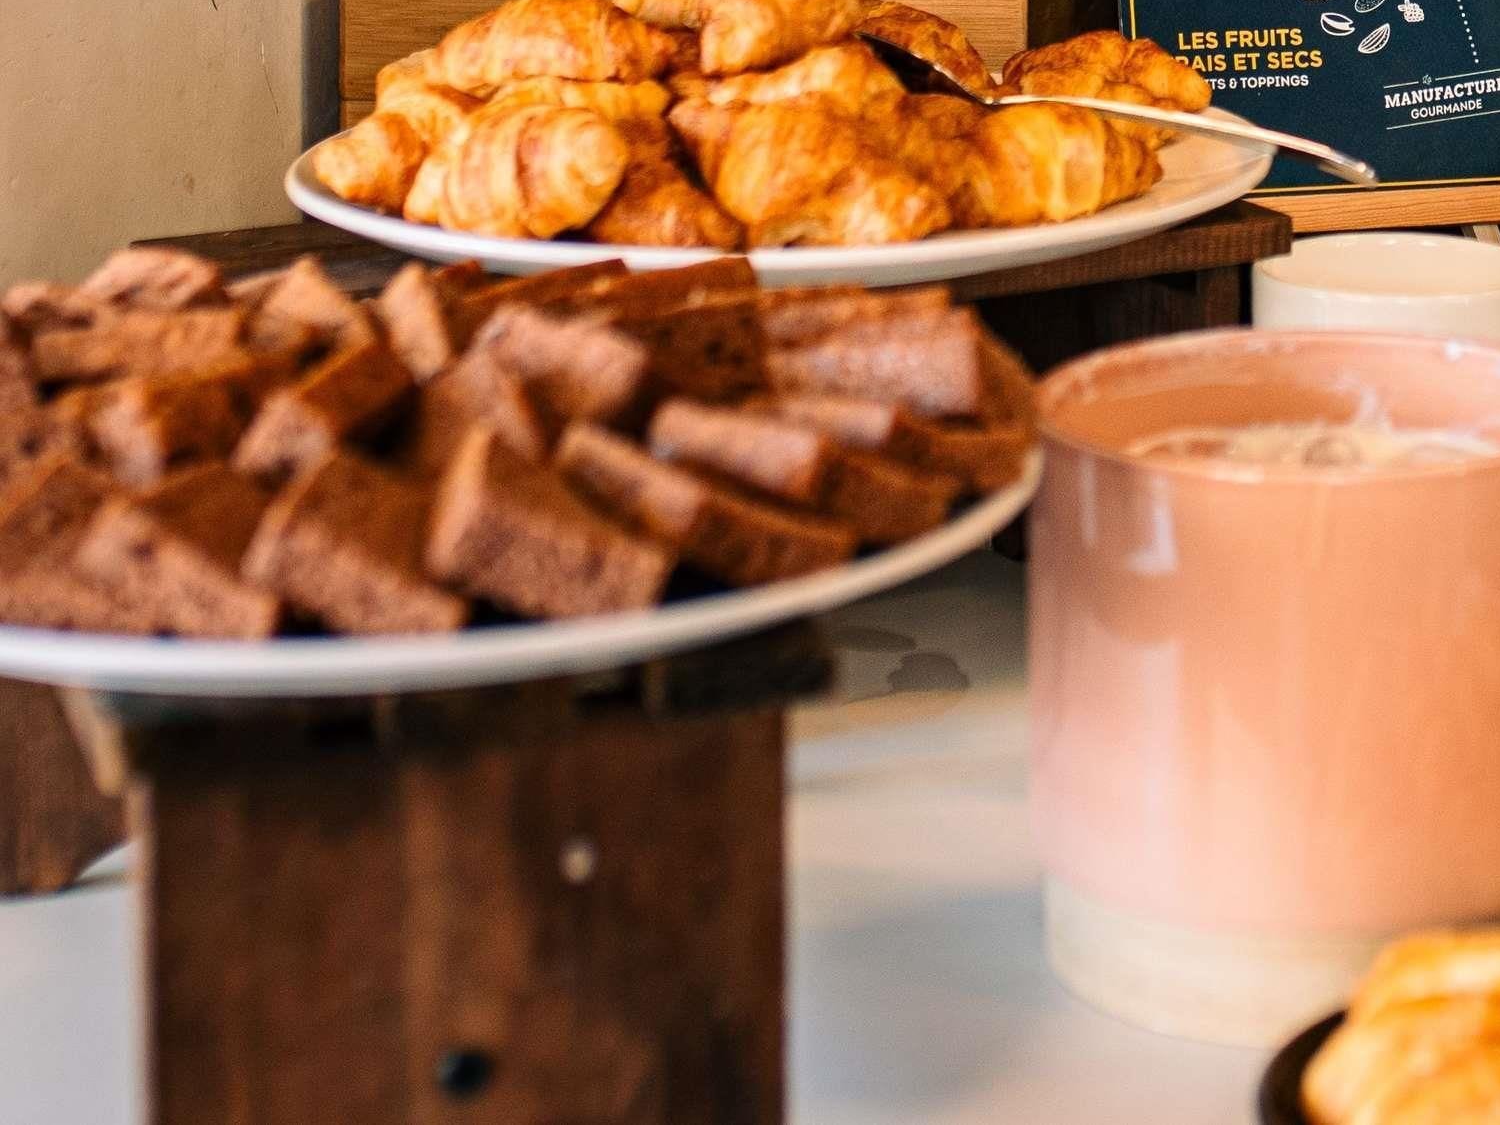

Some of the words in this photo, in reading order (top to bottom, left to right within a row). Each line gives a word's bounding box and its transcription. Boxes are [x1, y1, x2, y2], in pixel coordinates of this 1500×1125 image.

[1178, 32, 1219, 51] LES
[1225, 28, 1303, 48] FRUITS
[1233, 53, 1261, 71] ET
[1267, 50, 1323, 70] SECS
[1228, 77, 1238, 89] &
[1240, 74, 1309, 88] TOPPINGS
[1411, 99, 1483, 119] GOURMANDE
